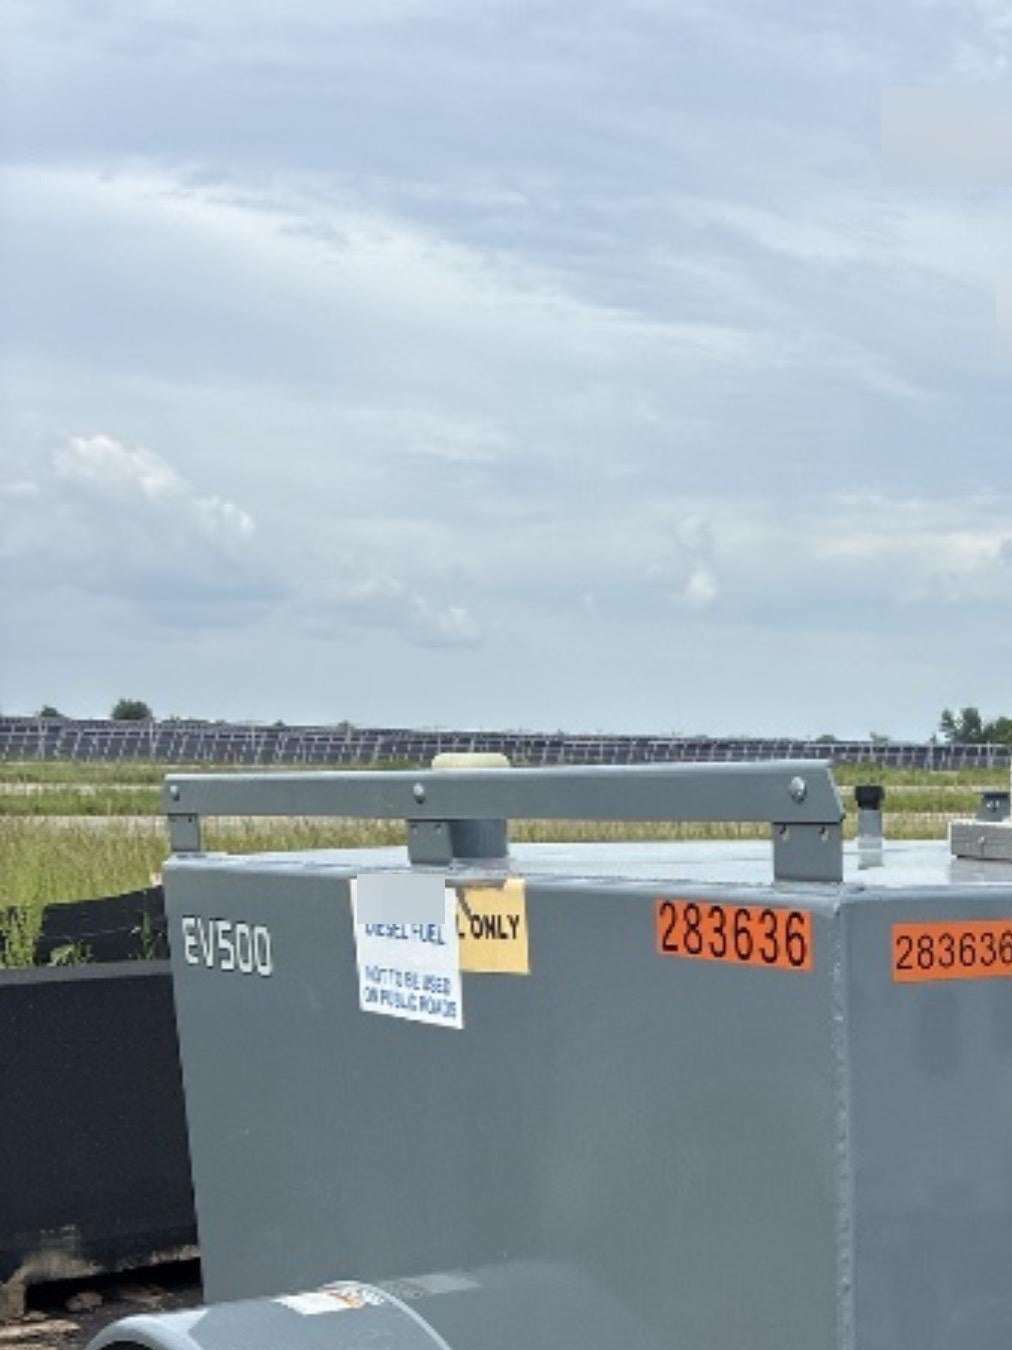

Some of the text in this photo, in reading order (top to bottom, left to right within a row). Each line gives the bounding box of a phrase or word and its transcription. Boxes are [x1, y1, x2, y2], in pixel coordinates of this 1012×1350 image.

[182, 915, 272, 978] EV500
[470, 914, 519, 939] ONLY
[658, 901, 806, 966] 283636
